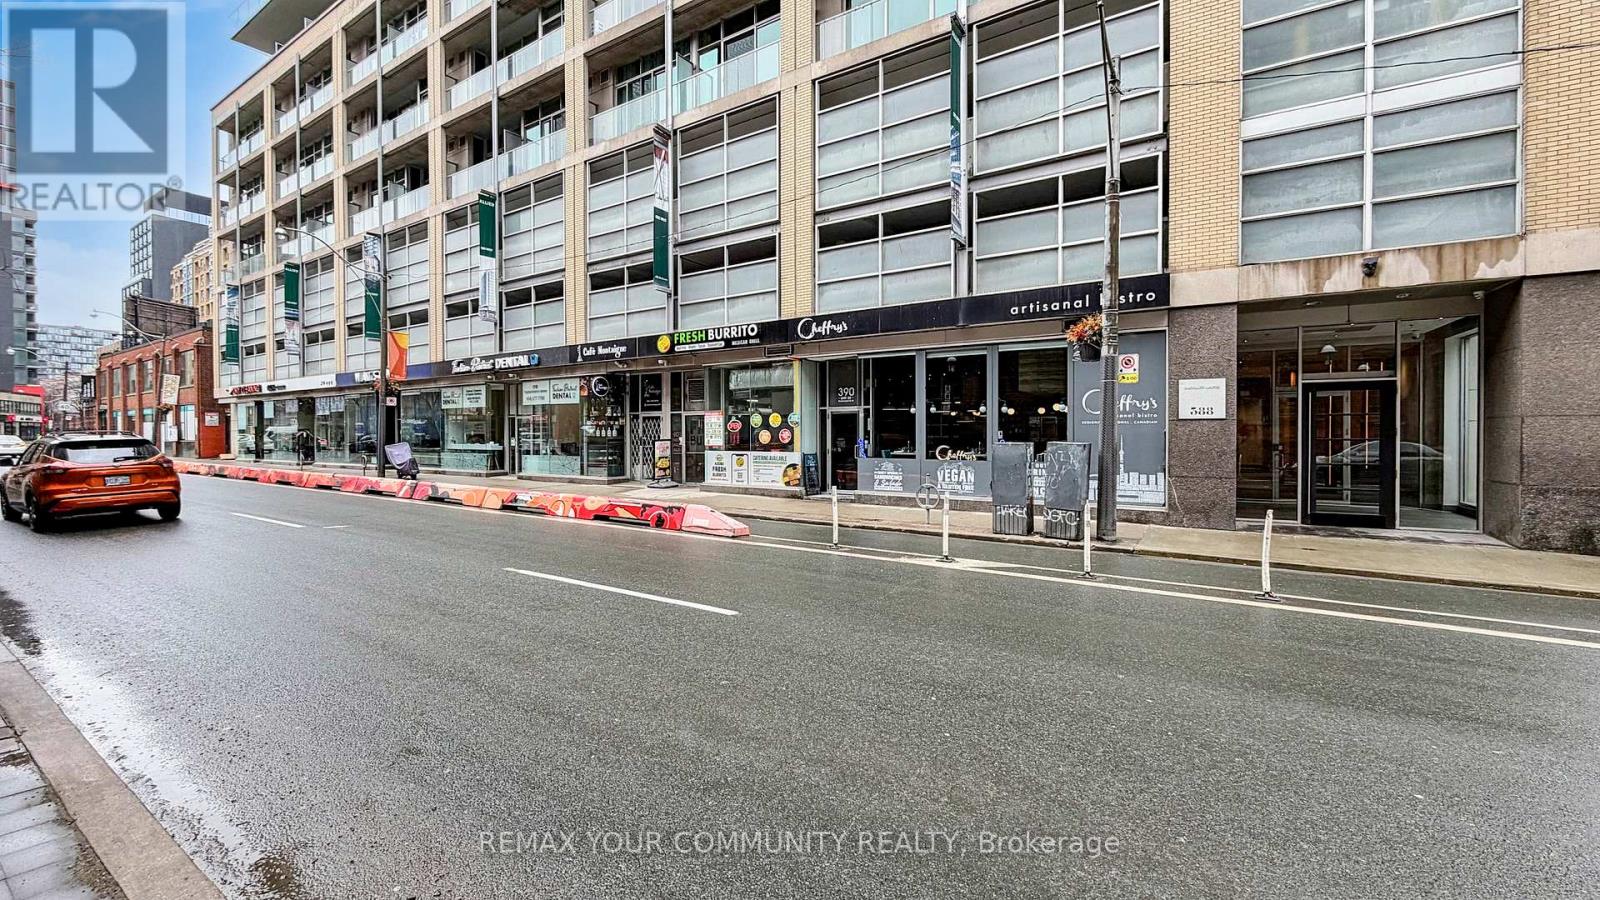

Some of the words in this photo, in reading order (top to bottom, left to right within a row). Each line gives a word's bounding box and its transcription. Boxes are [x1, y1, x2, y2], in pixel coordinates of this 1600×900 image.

[1010, 294, 1090, 315] artisanal
[674, 330, 705, 344] FRESH
[707, 323, 758, 341] BURRITO
[797, 317, 848, 339] Cheffry's
[495, 355, 530, 369] DENTAL
[838, 387, 855, 397] 390
[937, 469, 975, 483] VEGAN
